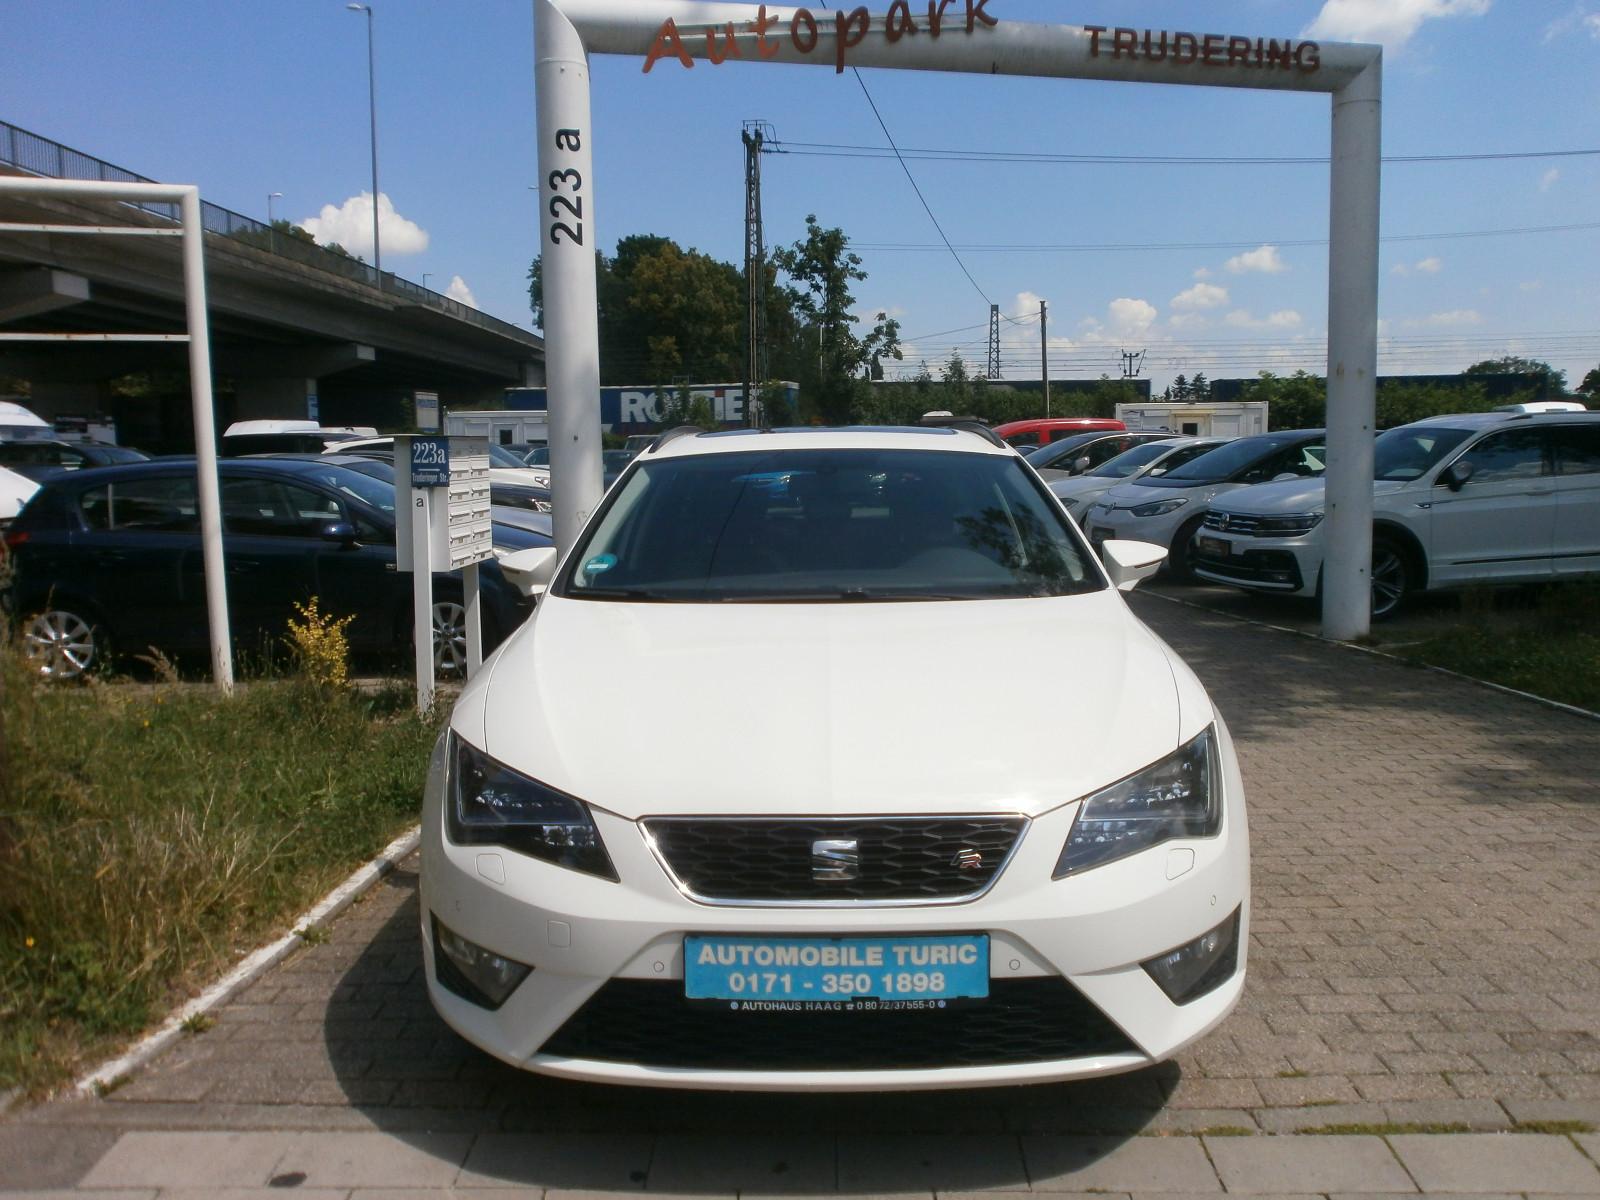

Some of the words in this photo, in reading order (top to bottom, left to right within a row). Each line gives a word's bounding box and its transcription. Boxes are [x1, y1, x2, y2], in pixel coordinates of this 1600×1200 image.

[641, 0, 999, 74] Autopark
[1084, 25, 1321, 73] TRUDERING
[555, 128, 581, 152] a
[548, 168, 583, 247] 223
[413, 442, 447, 464] 223a
[416, 498, 424, 507] a
[698, 944, 883, 967] AUTOMOBILE
[892, 944, 978, 964] TURIC
[729, 973, 791, 993] 0171
[822, 974, 871, 993] 350
[883, 972, 945, 993] 1898
[742, 1001, 802, 1011] AUTOHAUS
[806, 1001, 842, 1011] HAAG
